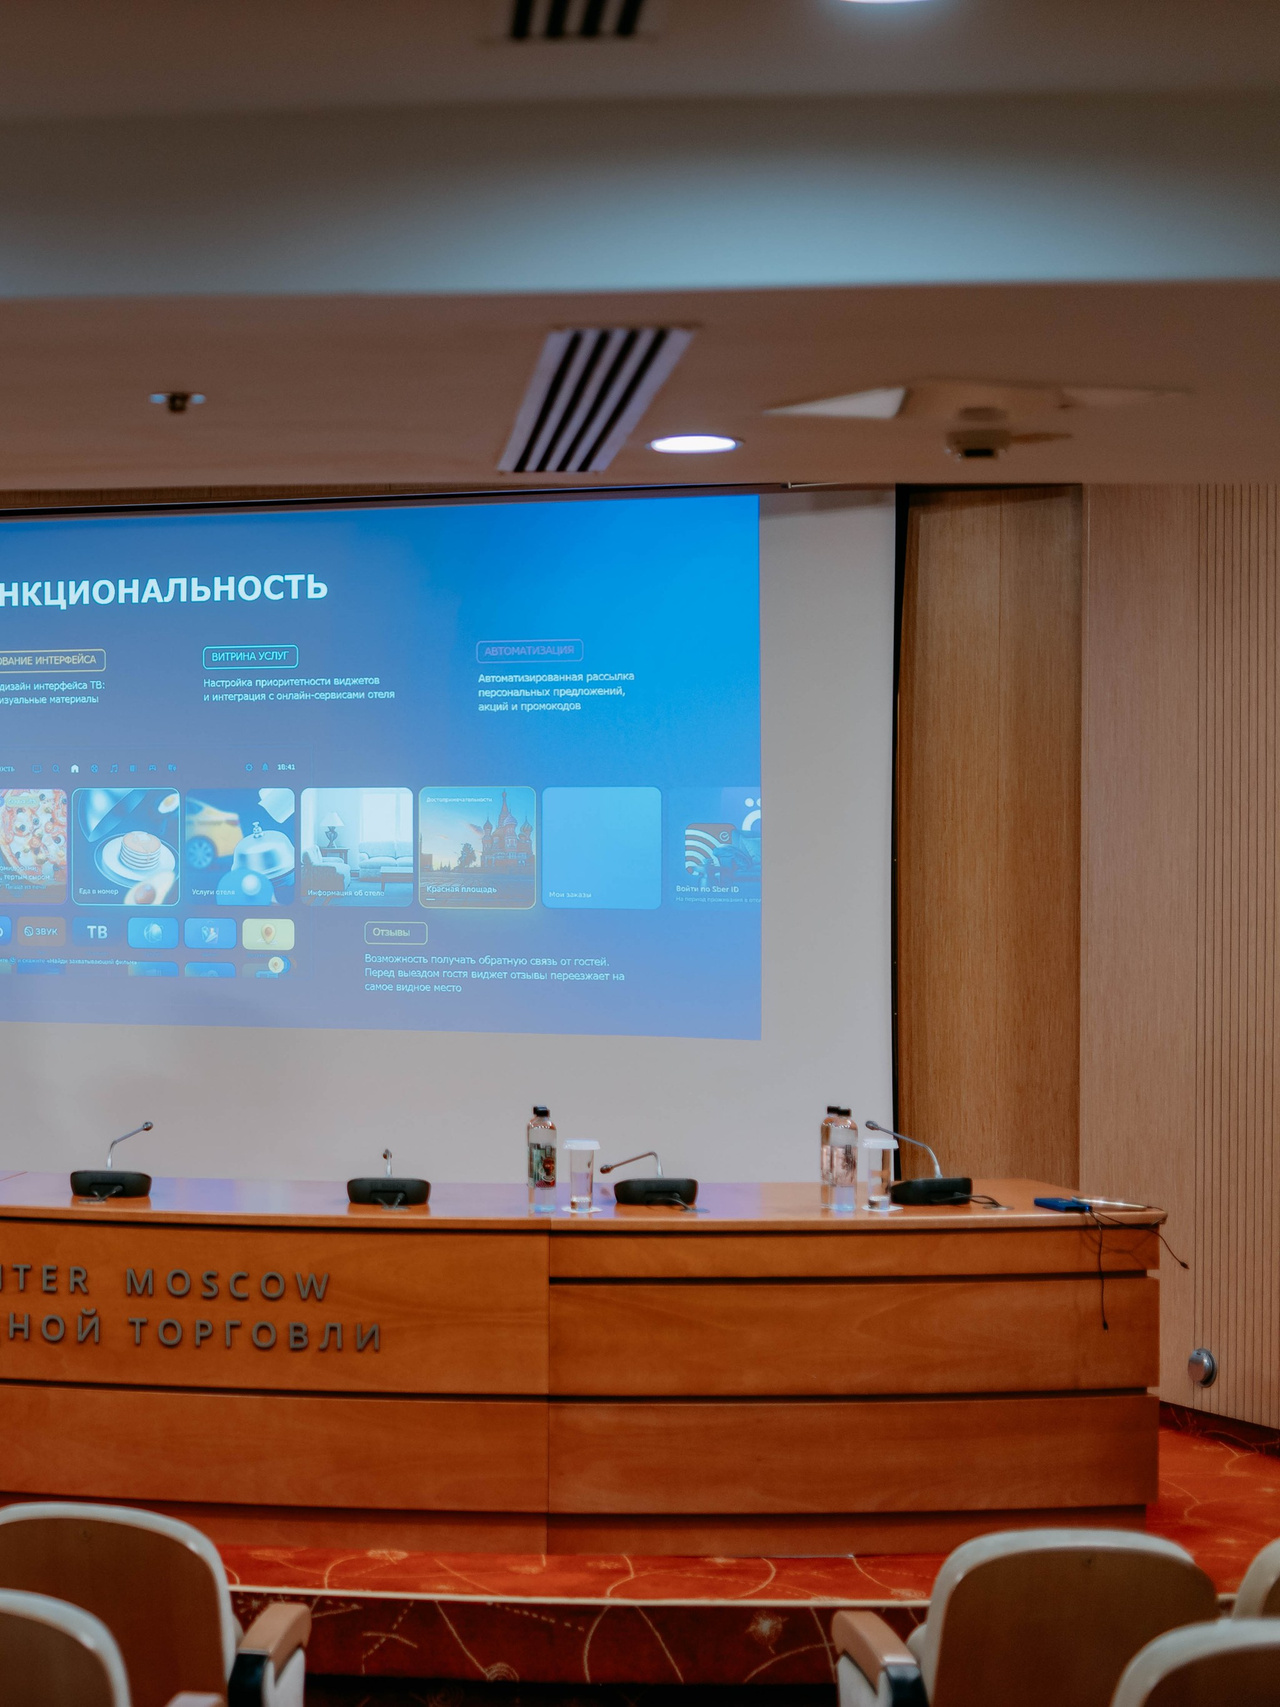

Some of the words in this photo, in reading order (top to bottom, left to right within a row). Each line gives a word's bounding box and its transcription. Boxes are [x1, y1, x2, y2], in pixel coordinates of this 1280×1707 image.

[212, 652, 256, 661] ВИТРИНА
[259, 651, 289, 660] УСЛУГ
[485, 646, 574, 656] АВТОМАТИЗАЦИЯ
[36, 653, 96, 664] ИНТЕРФЕЙСА
[204, 678, 252, 688] Настройка
[256, 677, 331, 687] приоритетности
[334, 677, 380, 686] виджетов
[478, 674, 583, 684] Автоматизированная
[586, 673, 634, 682] рассылка
[0, 682, 31, 692] дизайн
[33, 681, 87, 691] интерфейса
[90, 681, 105, 689] ТВ:
[204, 693, 209, 701] и
[213, 692, 265, 702] интеграция
[277, 691, 365, 701] онлайн-сервисами
[368, 691, 395, 699] отеля
[478, 688, 550, 698] персональных
[554, 687, 625, 697] предложений,
[50, 695, 99, 705] материалы
[478, 702, 508, 712] акций
[512, 703, 518, 711] и
[521, 702, 581, 712] промокодов
[426, 886, 459, 894] Красная
[462, 886, 497, 894] площадь
[87, 926, 107, 939] ТВ
[373, 928, 410, 937] Отзывы
[364, 954, 428, 964] Возможность
[431, 955, 476, 965] получать
[479, 955, 527, 966] обратную
[530, 958, 557, 966] связь
[560, 958, 571, 966] от
[574, 956, 609, 967] гостей.
[364, 968, 395, 978] Перед
[398, 970, 439, 978] выездом
[442, 970, 468, 978] гостя
[471, 971, 507, 980] виджет
[510, 972, 547, 980] отзывы
[551, 973, 609, 981] переезжает
[364, 983, 393, 991] самое
[396, 983, 431, 992] видное
[434, 984, 462, 992] место
[126, 1268, 329, 1299] MOSCOW
[129, 1317, 381, 1351] ТОРГОВЛИ
